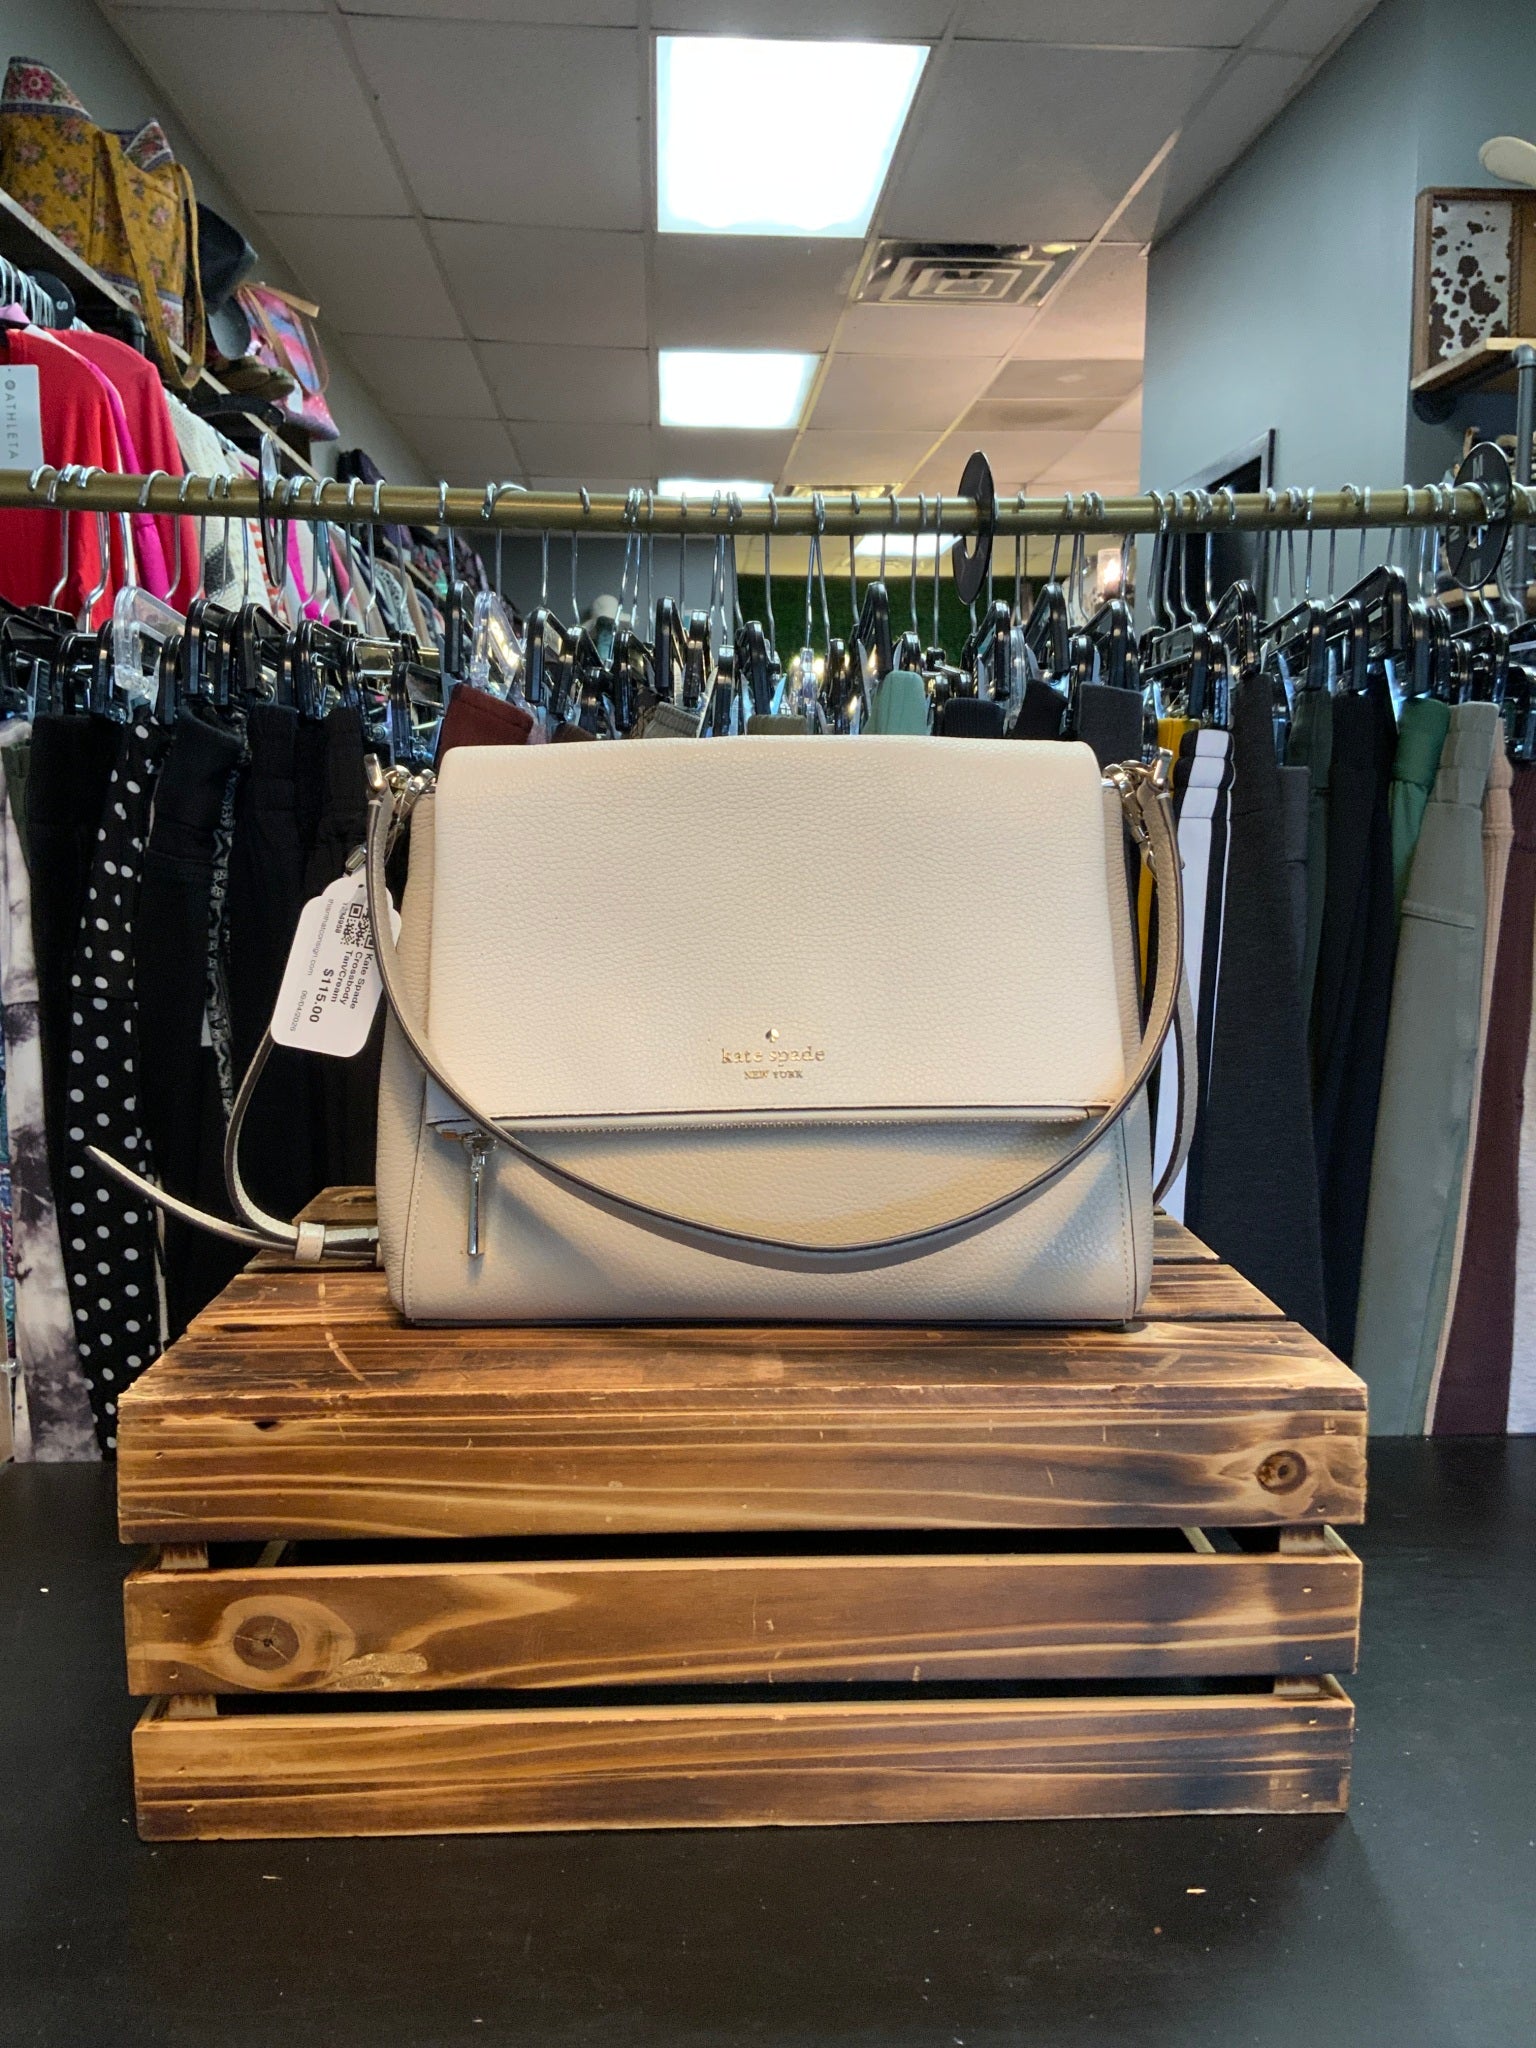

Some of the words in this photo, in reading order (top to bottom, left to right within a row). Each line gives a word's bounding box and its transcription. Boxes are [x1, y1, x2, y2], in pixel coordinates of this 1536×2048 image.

[5, 393, 20, 460] ATHLETA
[330, 950, 349, 1003] Tan/Cream
[338, 951, 363, 1006] Crossbody
[360, 952, 374, 977] Kate
[309, 968, 335, 1023] $115.00
[350, 977, 366, 1010] Spade
[721, 1047, 763, 1064] kate
[768, 1045, 825, 1067] spade
[744, 1070, 769, 1080] NEW
[773, 1070, 803, 1079] YORK
